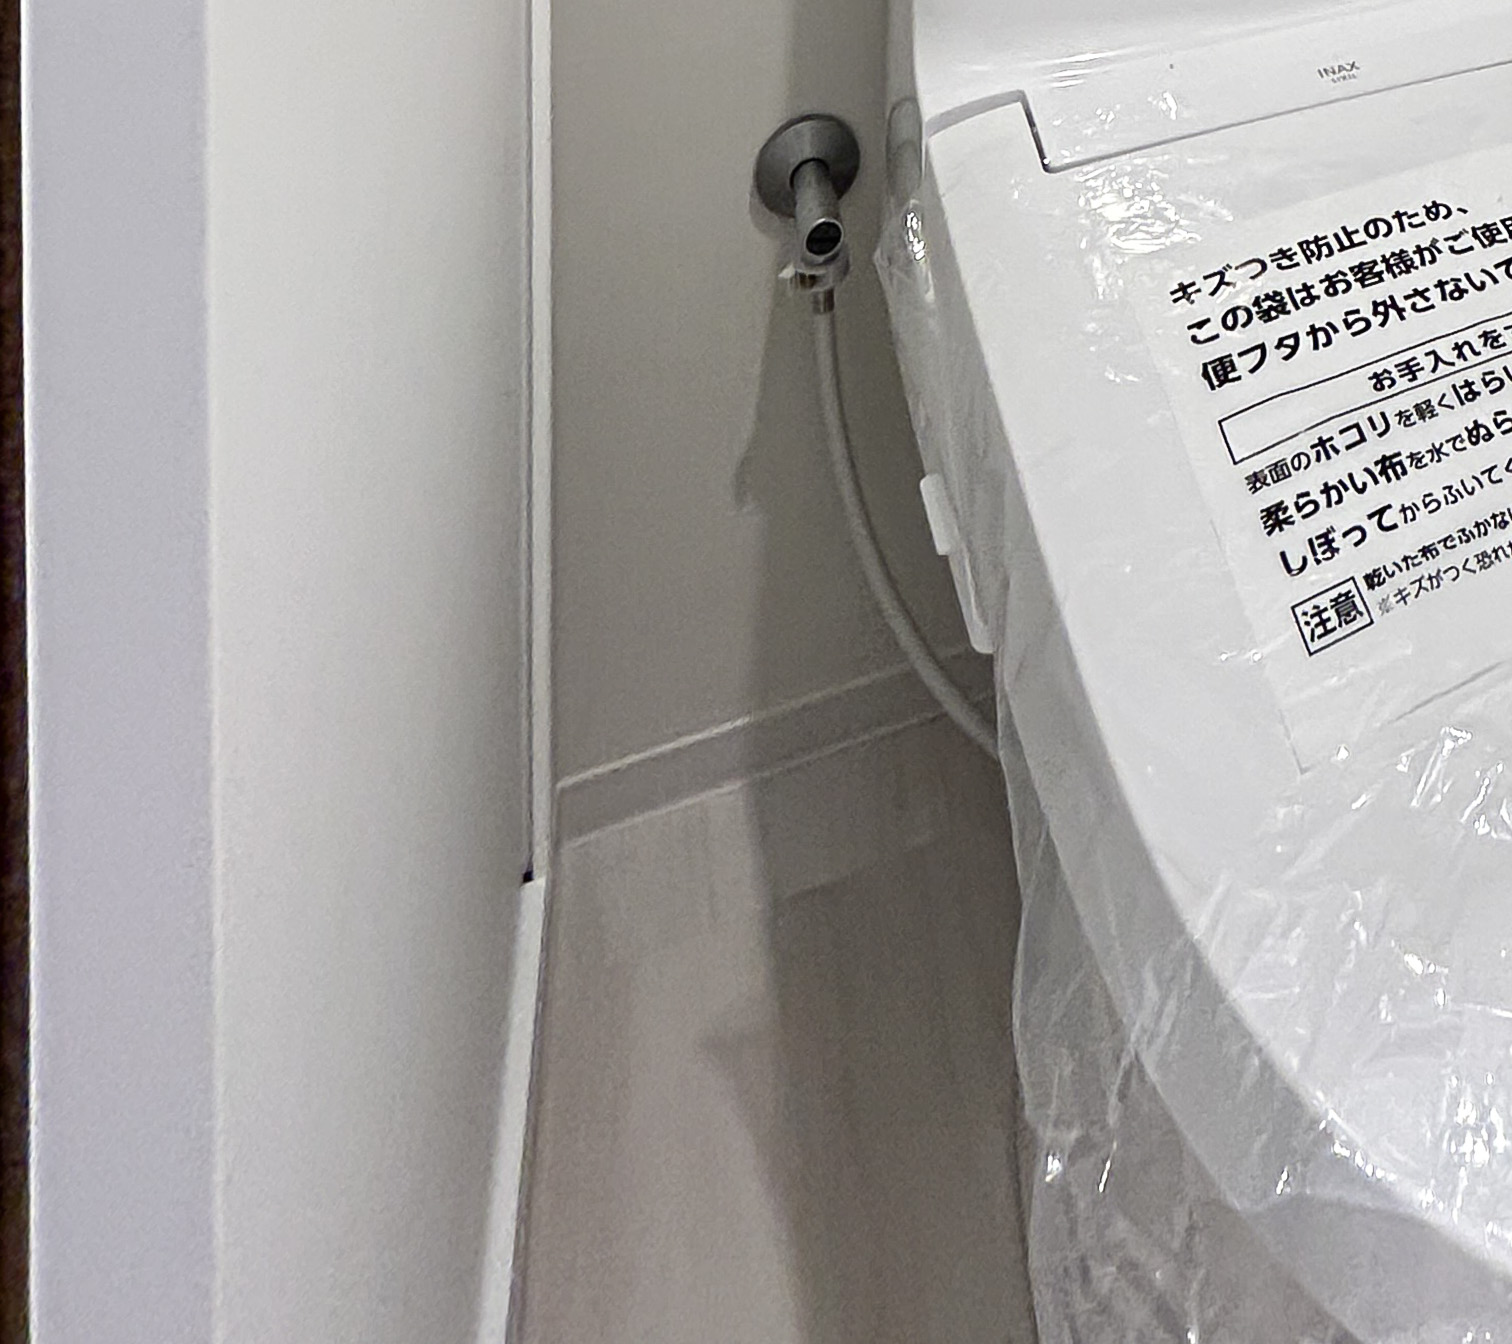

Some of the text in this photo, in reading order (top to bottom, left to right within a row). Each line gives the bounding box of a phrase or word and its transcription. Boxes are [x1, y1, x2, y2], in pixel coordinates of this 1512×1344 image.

[1317, 60, 1361, 79] INAX
[1169, 199, 1469, 305] キズつき防止のため、
[1300, 590, 1365, 644] 注意
